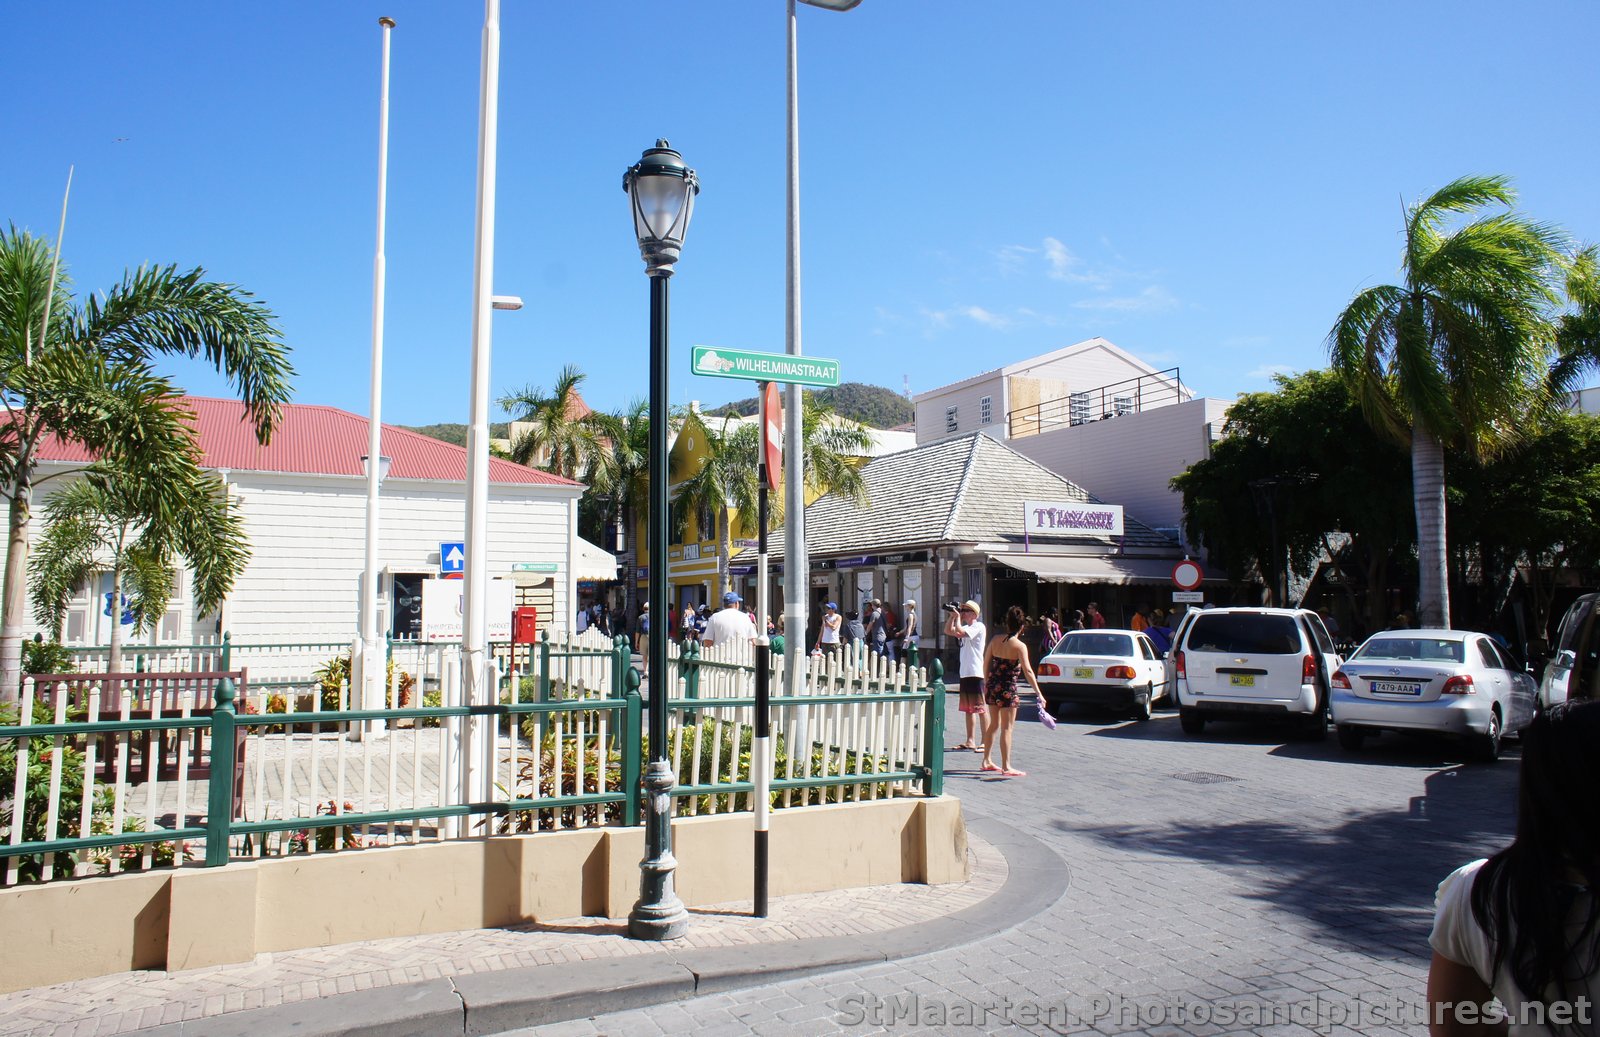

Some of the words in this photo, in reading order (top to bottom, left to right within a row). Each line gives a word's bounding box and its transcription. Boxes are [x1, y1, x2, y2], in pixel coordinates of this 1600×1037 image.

[736, 357, 836, 379] WILHELMINASTRAAT
[1056, 509, 1114, 523] TANZANITE
[1056, 520, 1114, 530] INTERNATIONAL
[683, 544, 700, 560] PENHA
[1376, 683, 1415, 693] 7479-AAA
